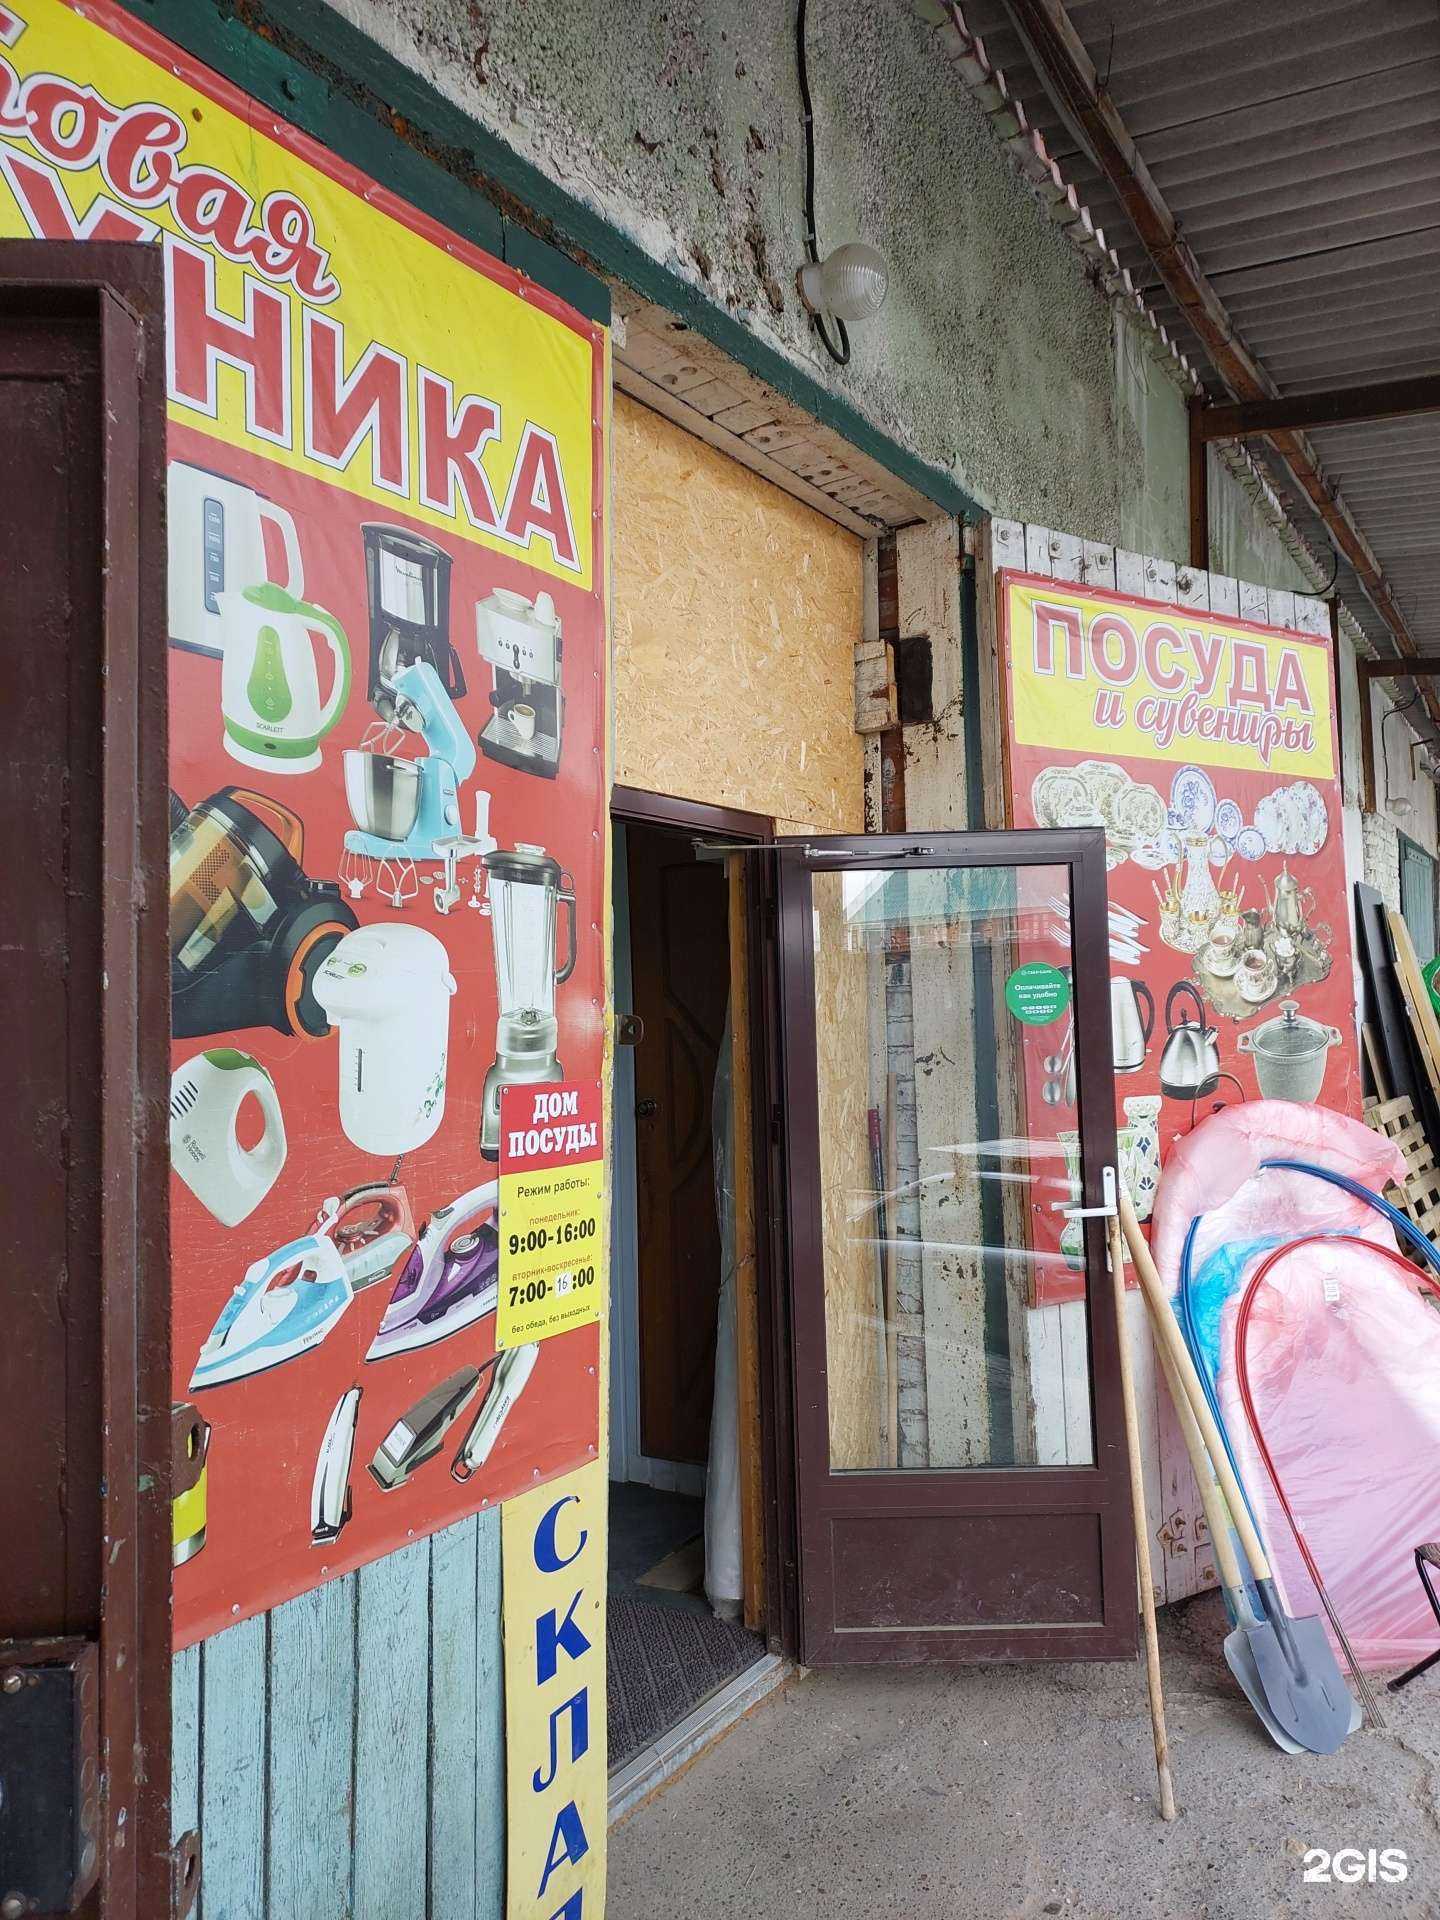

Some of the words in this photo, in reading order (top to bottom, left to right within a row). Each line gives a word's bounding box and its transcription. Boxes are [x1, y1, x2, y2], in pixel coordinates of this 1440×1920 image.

[1031, 598, 1315, 715] ПОСУДА
[1093, 688, 1126, 729] и
[1135, 690, 1317, 766] сувениры
[533, 1091, 578, 1124] ДОМ
[508, 1122, 598, 1158] ПОСУДЫ
[517, 1184, 551, 1198] Режим
[554, 1178, 590, 1195] работы:
[529, 1209, 581, 1226] понедельник:
[509, 1218, 596, 1255] 9:00-16:00
[512, 1254, 593, 1281] вторник-воскресенье:
[512, 1325, 524, 1334] без
[525, 1319, 548, 1330] обеда,
[549, 1313, 560, 1323] без
[560, 1305, 591, 1320] выходных
